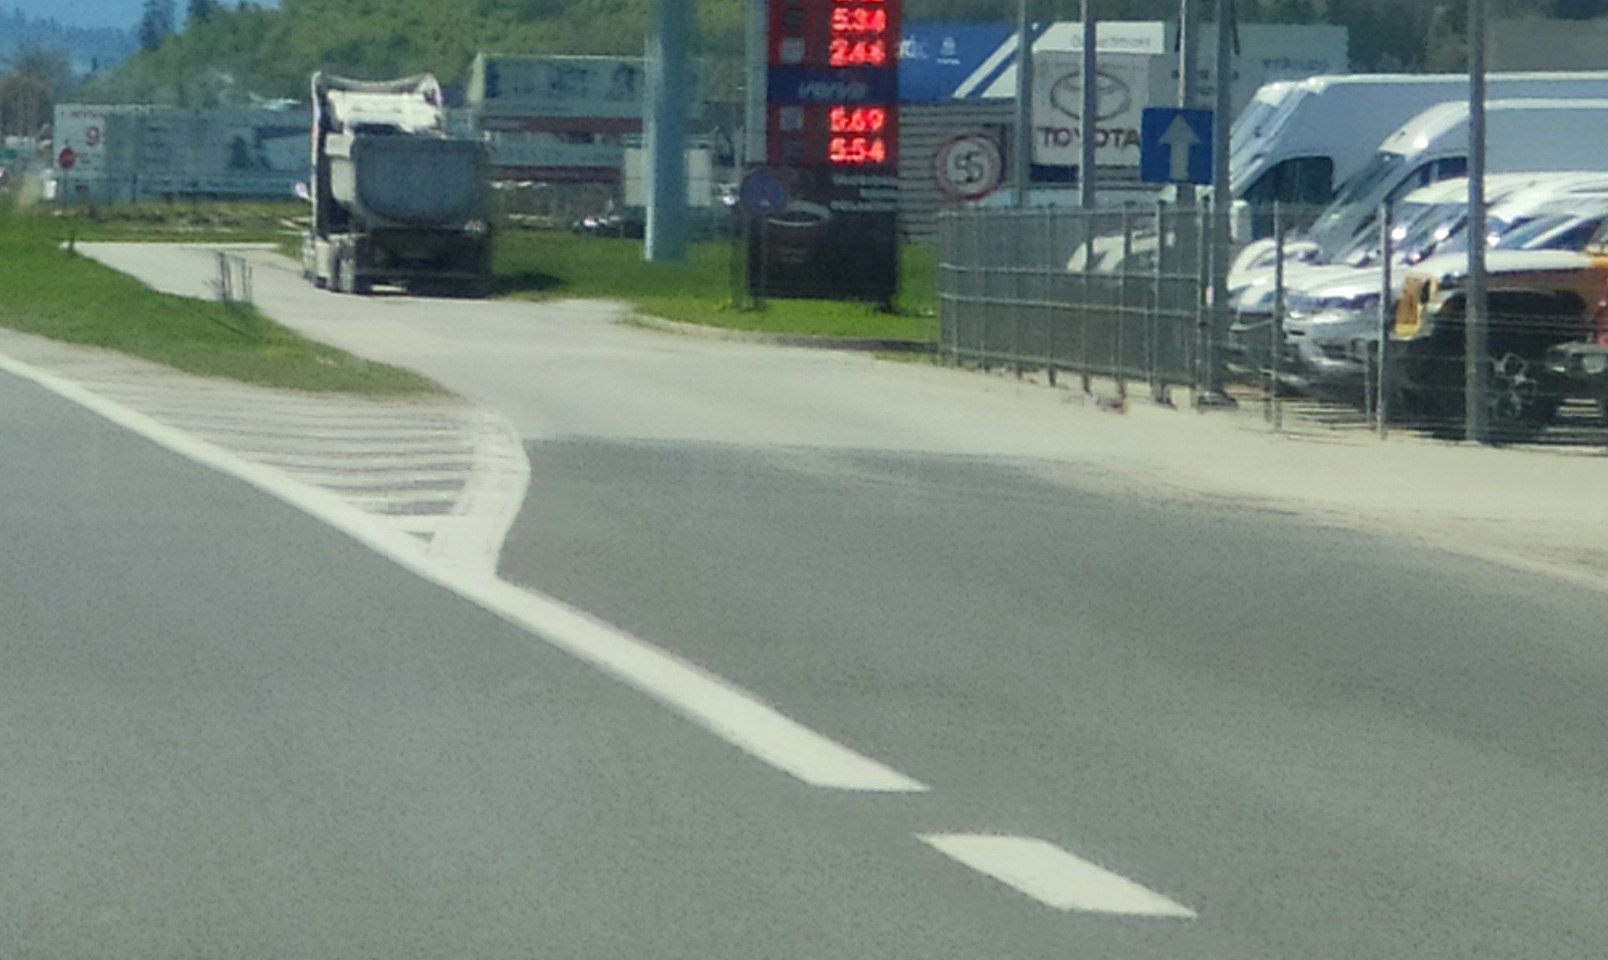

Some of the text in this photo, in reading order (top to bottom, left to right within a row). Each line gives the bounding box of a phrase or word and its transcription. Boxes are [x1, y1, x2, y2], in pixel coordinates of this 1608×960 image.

[832, 7, 886, 33] 5.34
[829, 106, 885, 132] 5.69
[829, 136, 885, 163] 5.54
[1036, 127, 1141, 148] TOOTA
